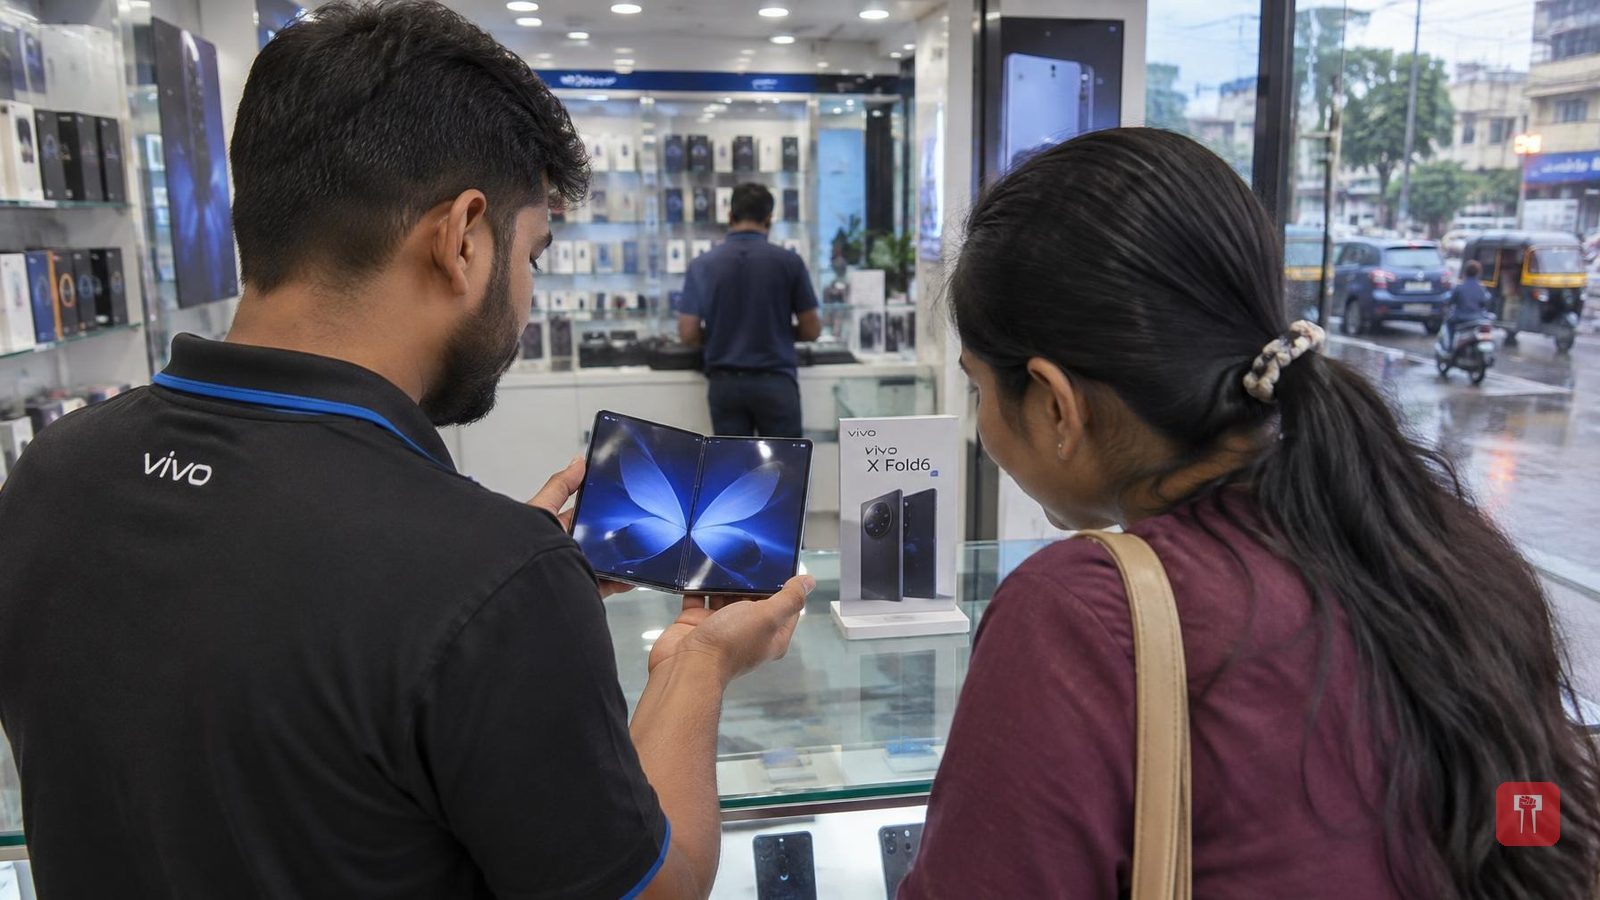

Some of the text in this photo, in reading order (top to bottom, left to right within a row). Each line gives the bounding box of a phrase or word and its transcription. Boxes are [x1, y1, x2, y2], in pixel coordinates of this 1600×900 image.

[848, 428, 877, 437] vivo
[865, 445, 898, 456] vivo
[144, 450, 213, 487] vivo
[867, 458, 931, 472] X Fold6
